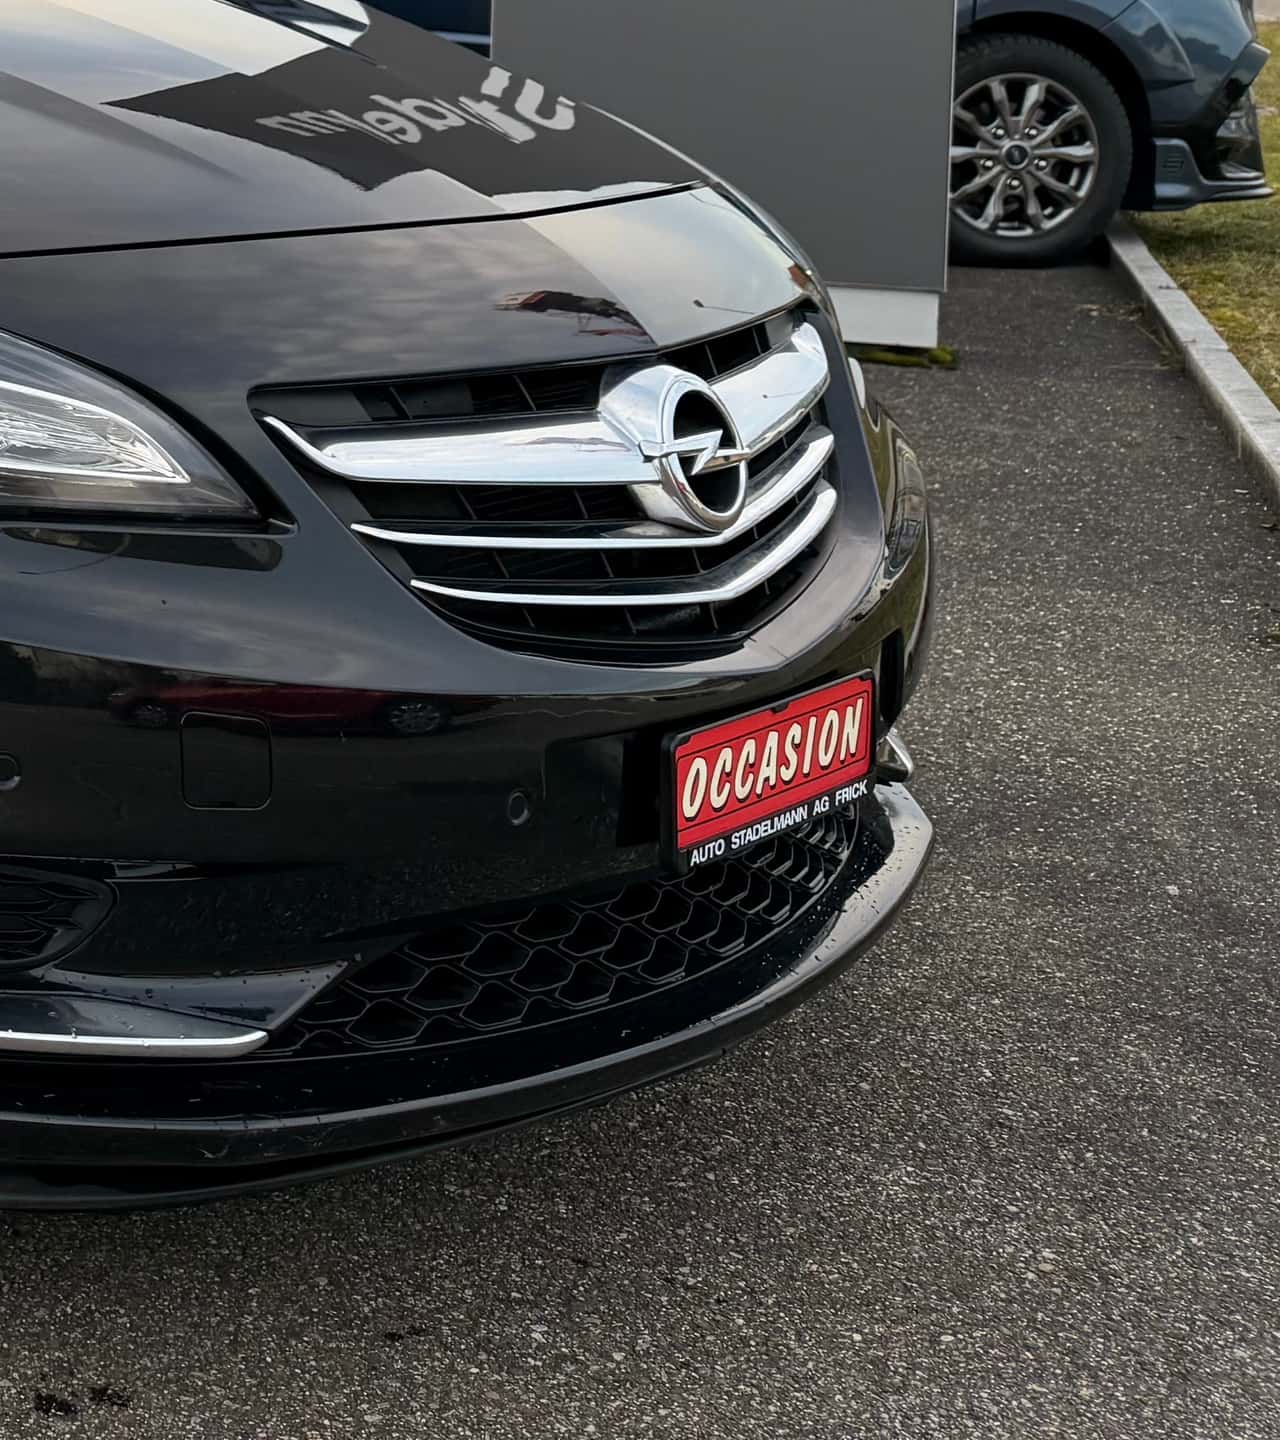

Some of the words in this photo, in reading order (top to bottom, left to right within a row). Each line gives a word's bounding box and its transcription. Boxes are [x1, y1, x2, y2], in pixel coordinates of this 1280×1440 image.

[682, 697, 864, 821] OCCASION
[690, 839, 726, 867] AUTO
[730, 806, 809, 850] STADELMANN
[813, 795, 830, 817] AG
[835, 778, 869, 806] FRICK
